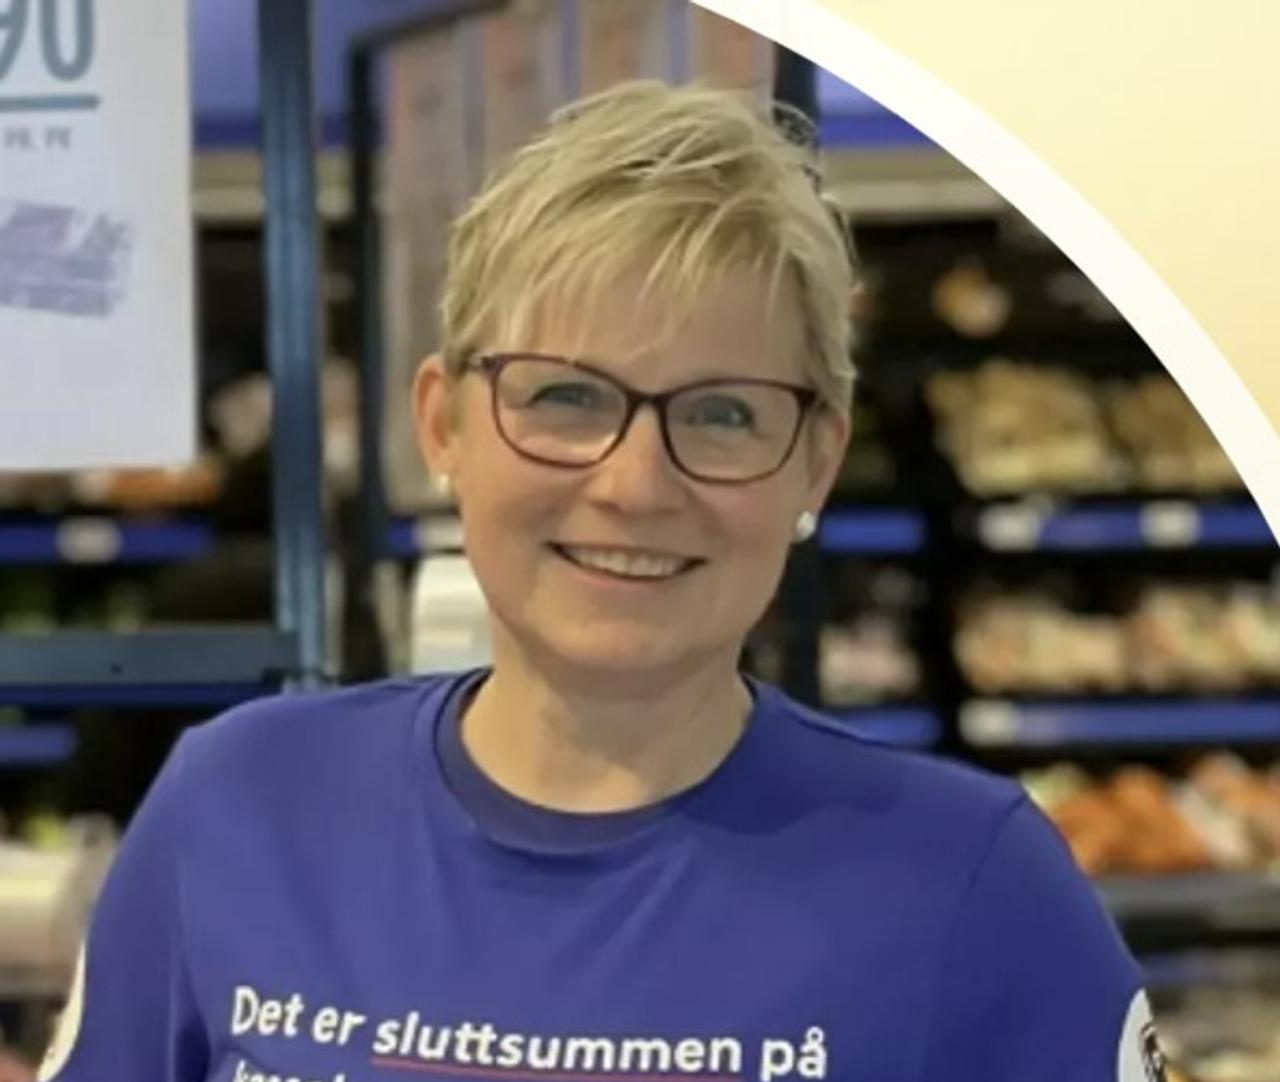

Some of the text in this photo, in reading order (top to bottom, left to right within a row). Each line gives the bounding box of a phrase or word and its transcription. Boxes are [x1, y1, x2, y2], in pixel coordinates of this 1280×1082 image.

[231, 984, 828, 1082] Det er sluttsummen på
